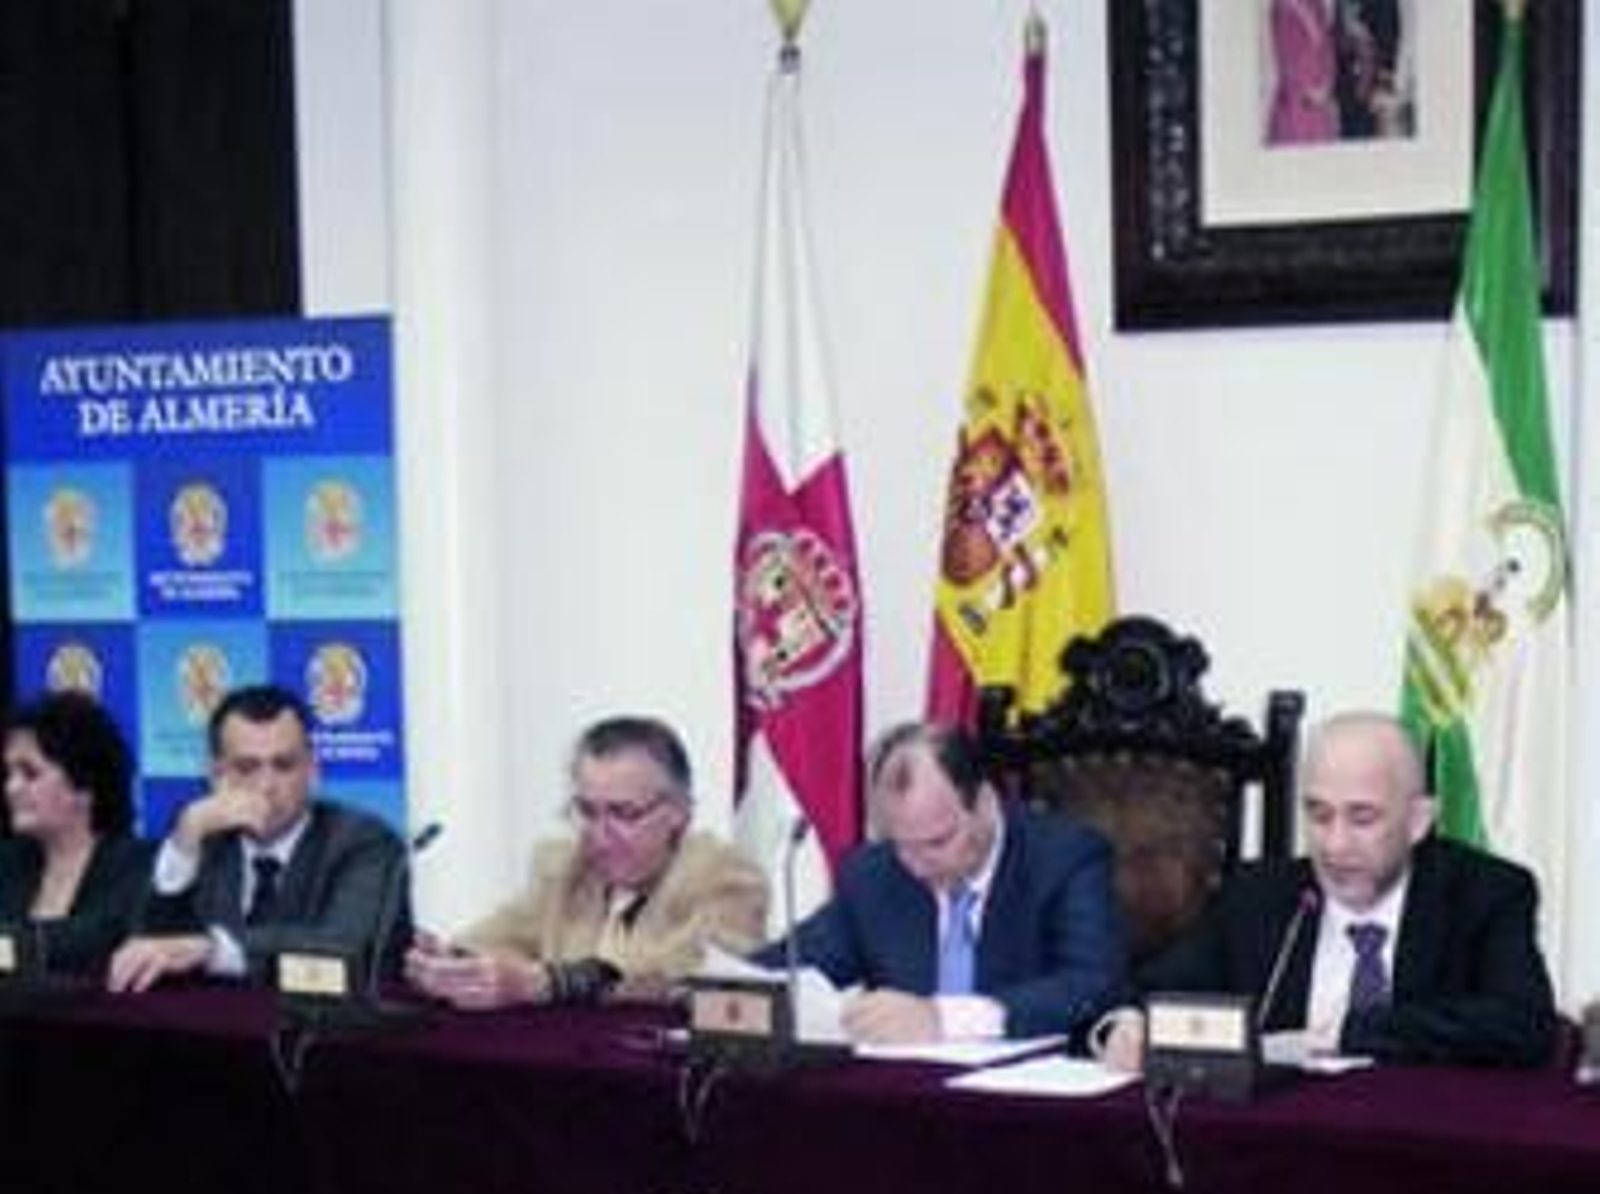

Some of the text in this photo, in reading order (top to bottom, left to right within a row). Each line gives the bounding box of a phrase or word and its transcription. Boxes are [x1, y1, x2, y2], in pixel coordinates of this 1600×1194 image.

[41, 347, 352, 393] AYUNTAMIENTO
[79, 386, 313, 436] DE ALMERÍA
